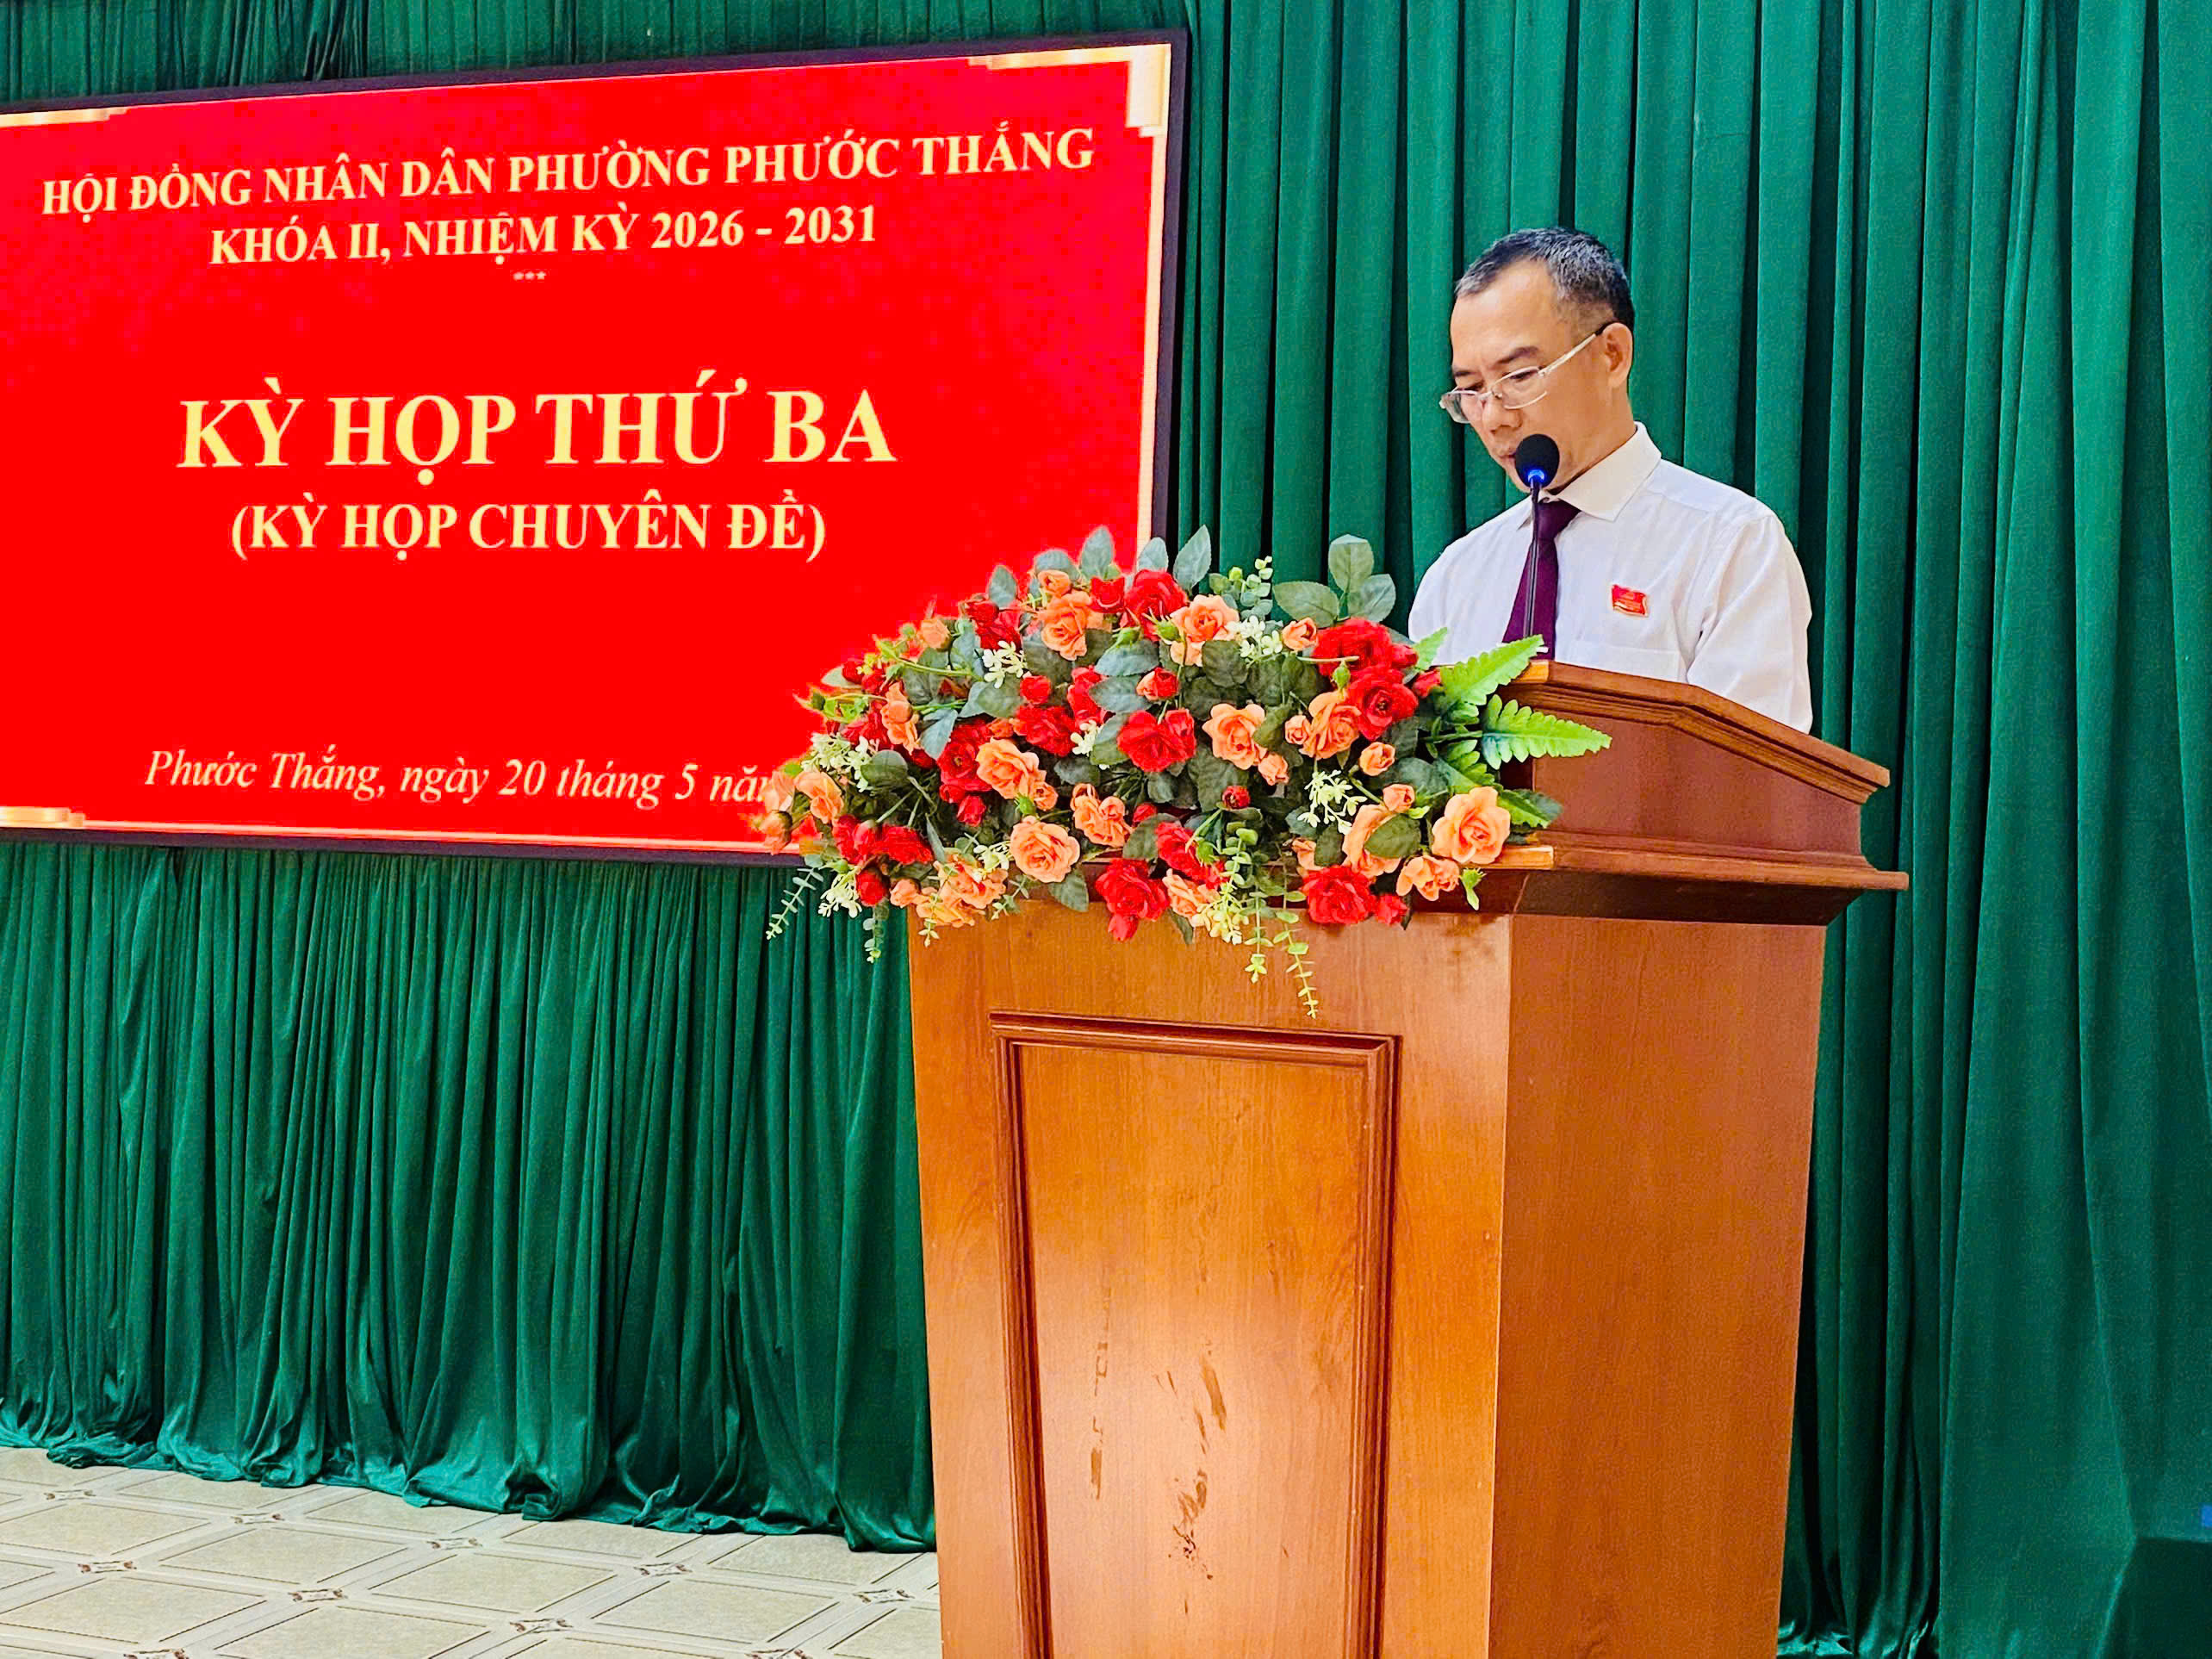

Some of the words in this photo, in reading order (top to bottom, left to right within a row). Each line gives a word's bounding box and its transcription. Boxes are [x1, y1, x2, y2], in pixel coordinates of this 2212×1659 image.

[43, 173, 117, 222] HỘI
[129, 164, 252, 209] ĐỒNG
[264, 152, 388, 202] NHÂN
[400, 147, 494, 196] DÂN
[510, 140, 710, 191] PHƯỜNG
[725, 129, 899, 183] PHƯỚC
[913, 121, 1093, 175] THẮNG
[210, 215, 337, 264] KHÓA
[349, 223, 390, 263] II,
[403, 213, 557, 264] NHIỆM
[572, 202, 639, 251] KỲ
[651, 210, 743, 248] 2026
[786, 205, 874, 244] 2031
[177, 377, 304, 467] KỲ
[326, 395, 516, 485] HỌP
[536, 370, 747, 463] THỨ
[765, 389, 896, 462] BA
[233, 493, 327, 559] (KỲ
[342, 504, 457, 560] HỌP
[469, 489, 710, 549] CHUYÊN
[727, 489, 825, 562] ĐỀ)
[145, 749, 257, 787] Phước
[271, 744, 384, 800] Thắng,
[401, 757, 489, 804] ngày
[499, 759, 546, 795] 20
[557, 760, 664, 809] tháng
[675, 763, 698, 799] 5
